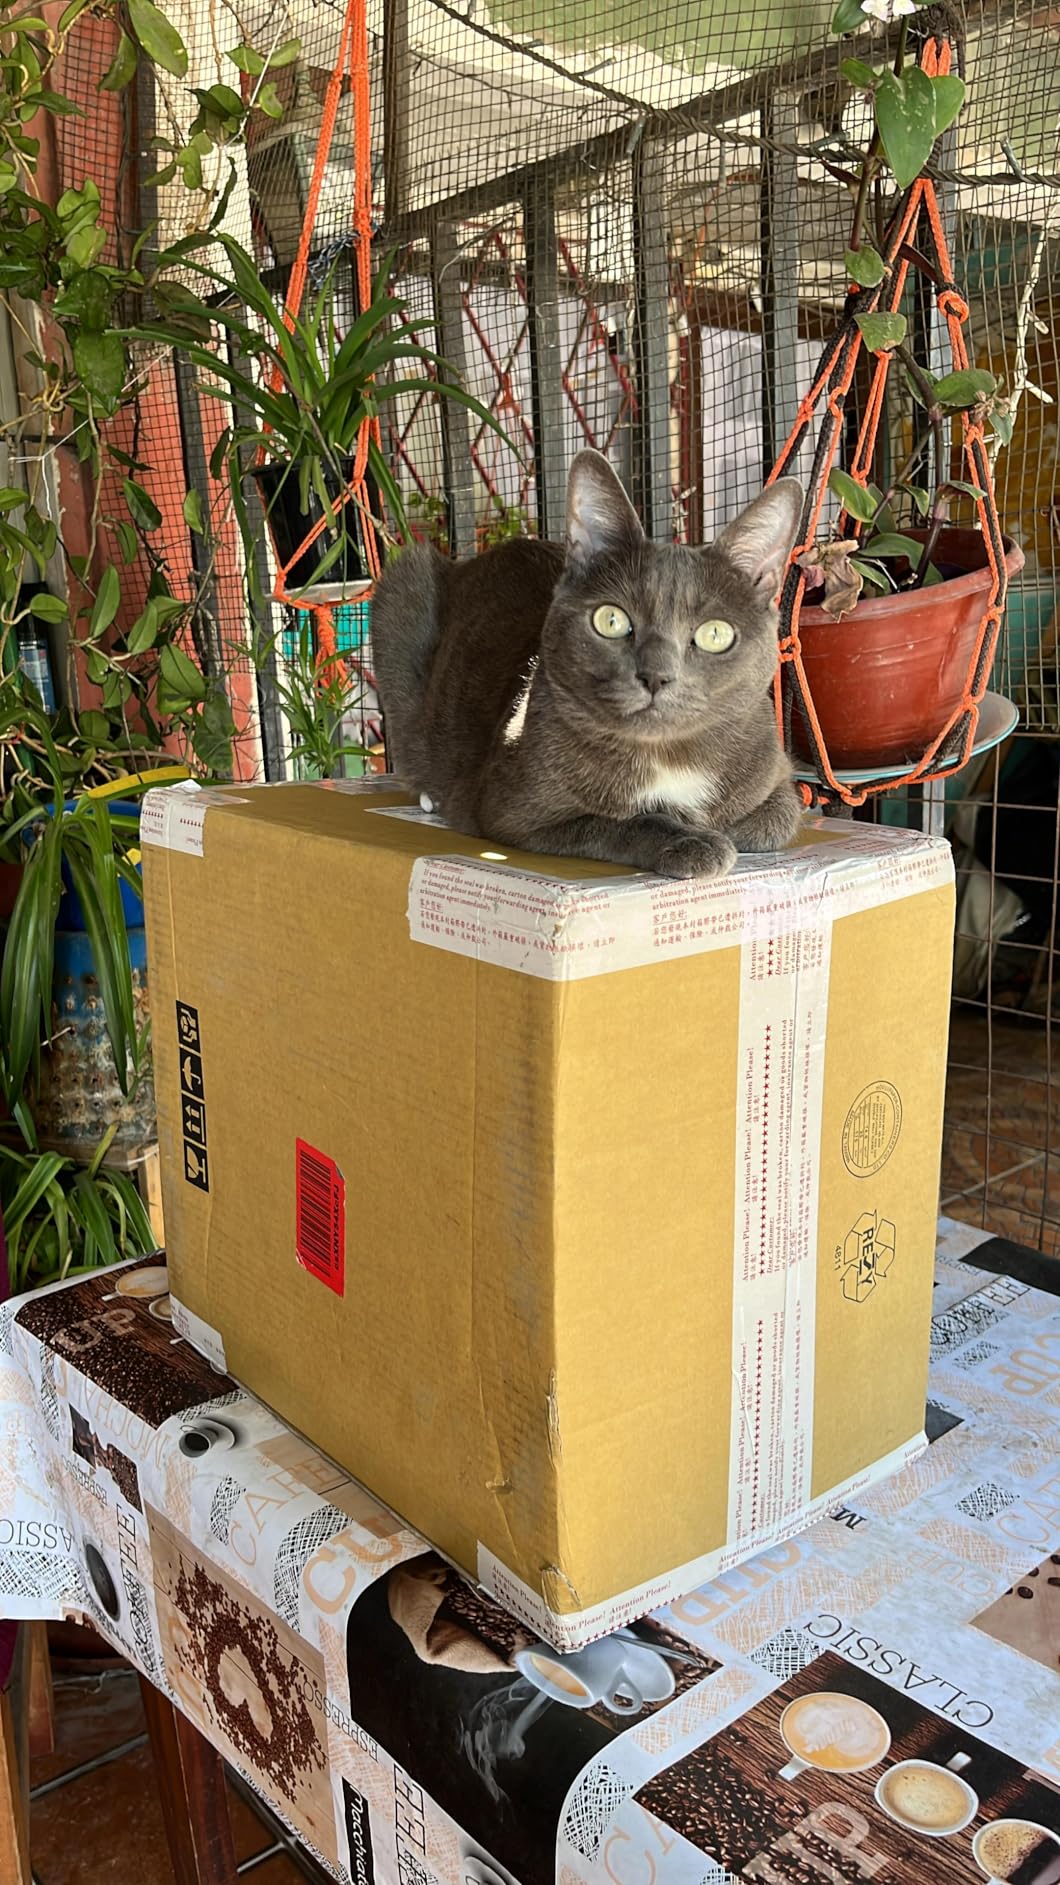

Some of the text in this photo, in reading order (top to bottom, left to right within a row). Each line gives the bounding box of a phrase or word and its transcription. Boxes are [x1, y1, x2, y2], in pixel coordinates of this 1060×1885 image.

[652, 898, 688, 910] arbitration
[690, 894, 708, 904] agent
[660, 888, 690, 900] damaged,
[692, 883, 712, 894] please
[714, 878, 733, 890] notify
[783, 966, 789, 974] If
[746, 1047, 754, 1079] Please!
[780, 1076, 785, 1084] or
[745, 1081, 753, 1123] Attention
[744, 1128, 752, 1160] Please!
[742, 1208, 750, 1240] Please!
[742, 1241, 750, 1281] Attention
[834, 1245, 842, 1271] 4811
[303, 1510, 405, 1615] CU
[579, 1611, 606, 1630] Please!
[609, 1596, 645, 1614] Attention
[645, 1580, 672, 1598] Please!
[803, 1613, 994, 1729] CLASSIC
[303, 1681, 379, 1763] ESPRESSO
